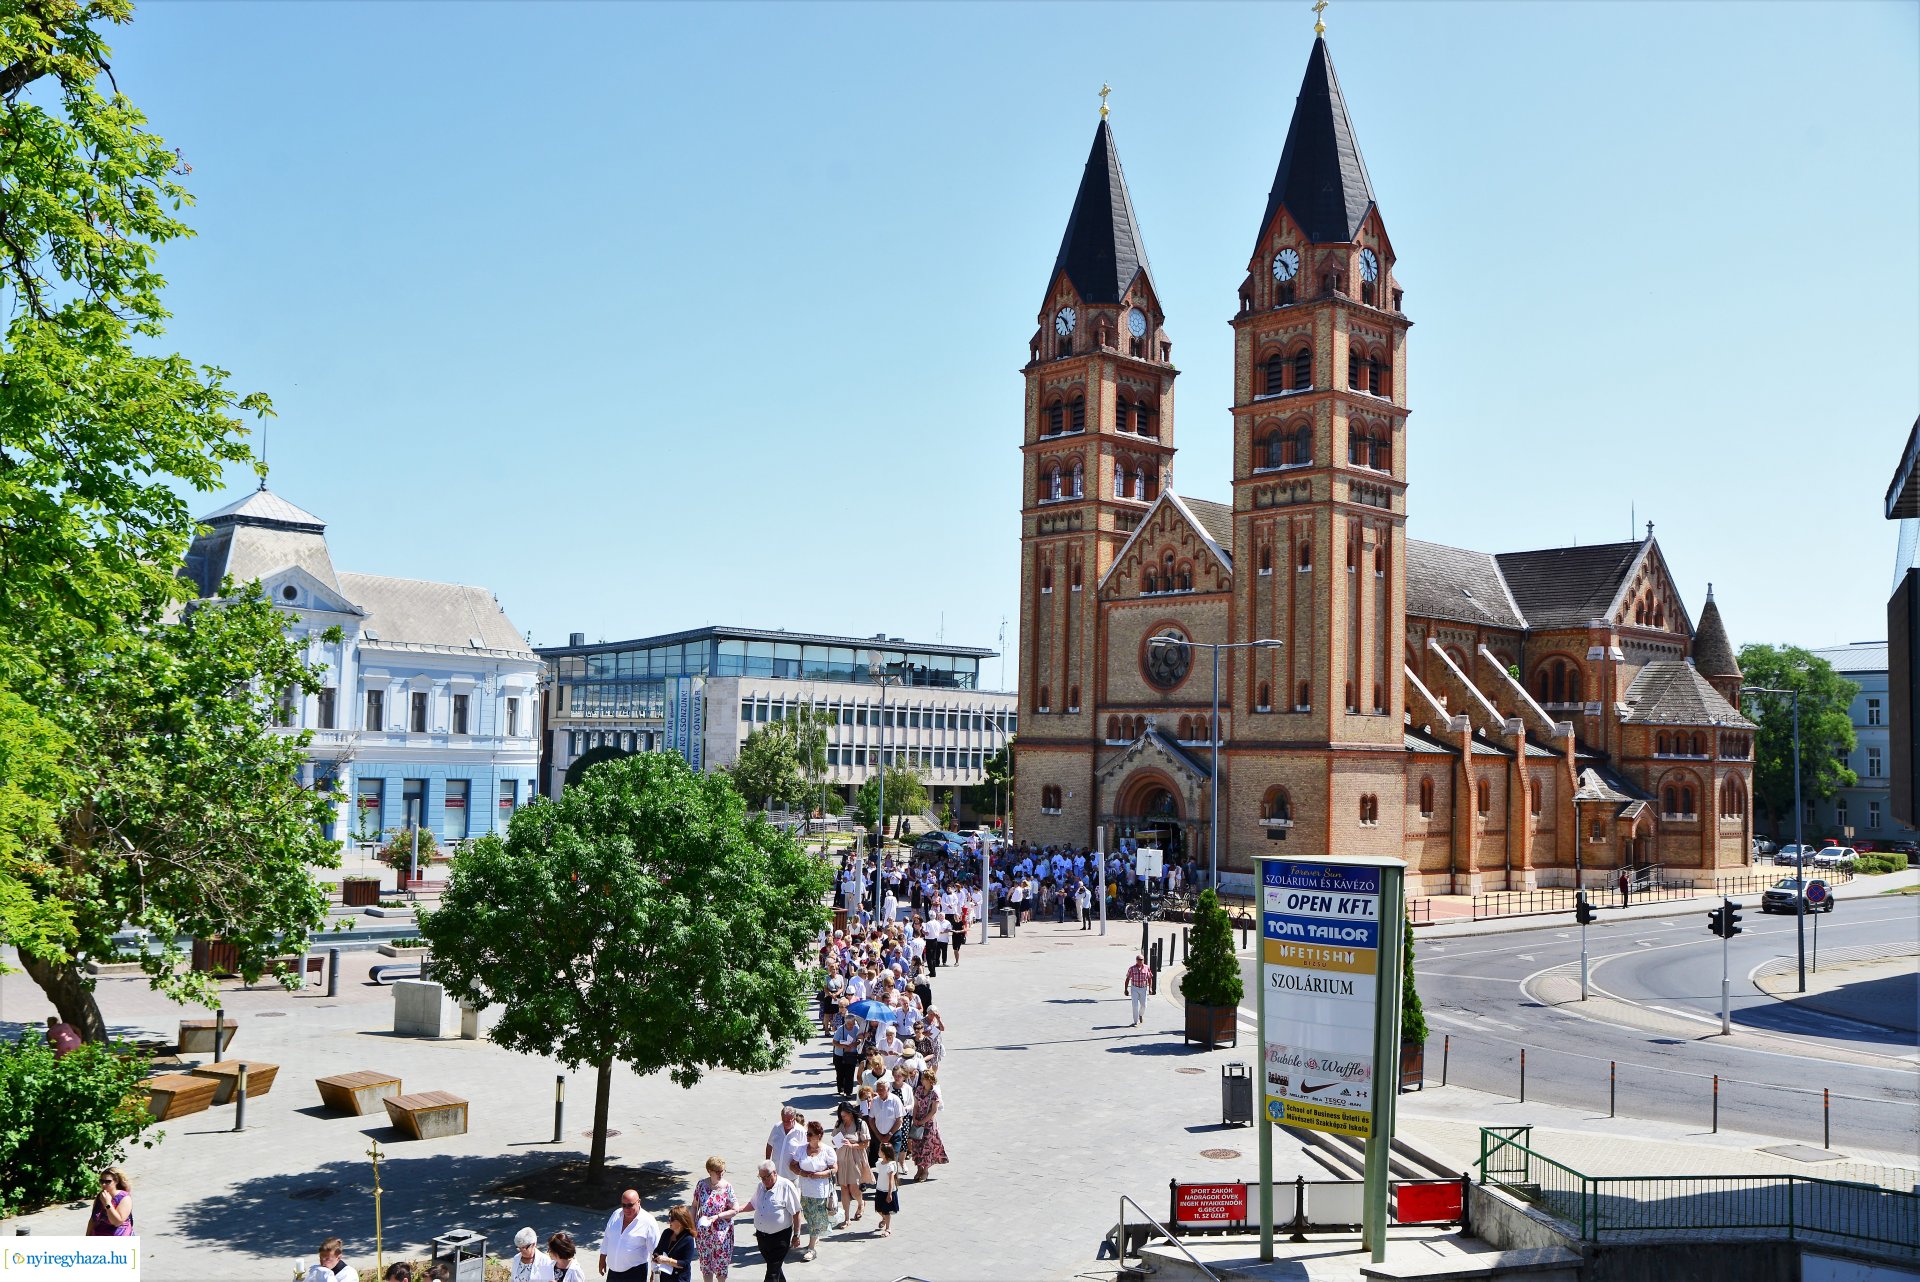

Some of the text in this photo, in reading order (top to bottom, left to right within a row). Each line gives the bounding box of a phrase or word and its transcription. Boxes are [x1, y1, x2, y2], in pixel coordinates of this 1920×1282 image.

[1290, 866, 1342, 878] Forever Sun
[1266, 874, 1374, 891] SZOLÁRIUM ÉS KÁVÉZÓ
[1288, 894, 1374, 915] OPEN KFT.
[1268, 920, 1368, 942] TOM TAILOR
[1290, 947, 1342, 962] FETISH
[1272, 972, 1354, 995] SZOLÁRIUM
[1270, 1051, 1364, 1078] Bubble Waffle
[1324, 1096, 1346, 1105] TESCO
[1286, 1104, 1304, 1114] School
[1314, 1110, 1340, 1120] Business
[1342, 1112, 1360, 1122] Üzleti
[1348, 1123, 1368, 1132] Iskola
